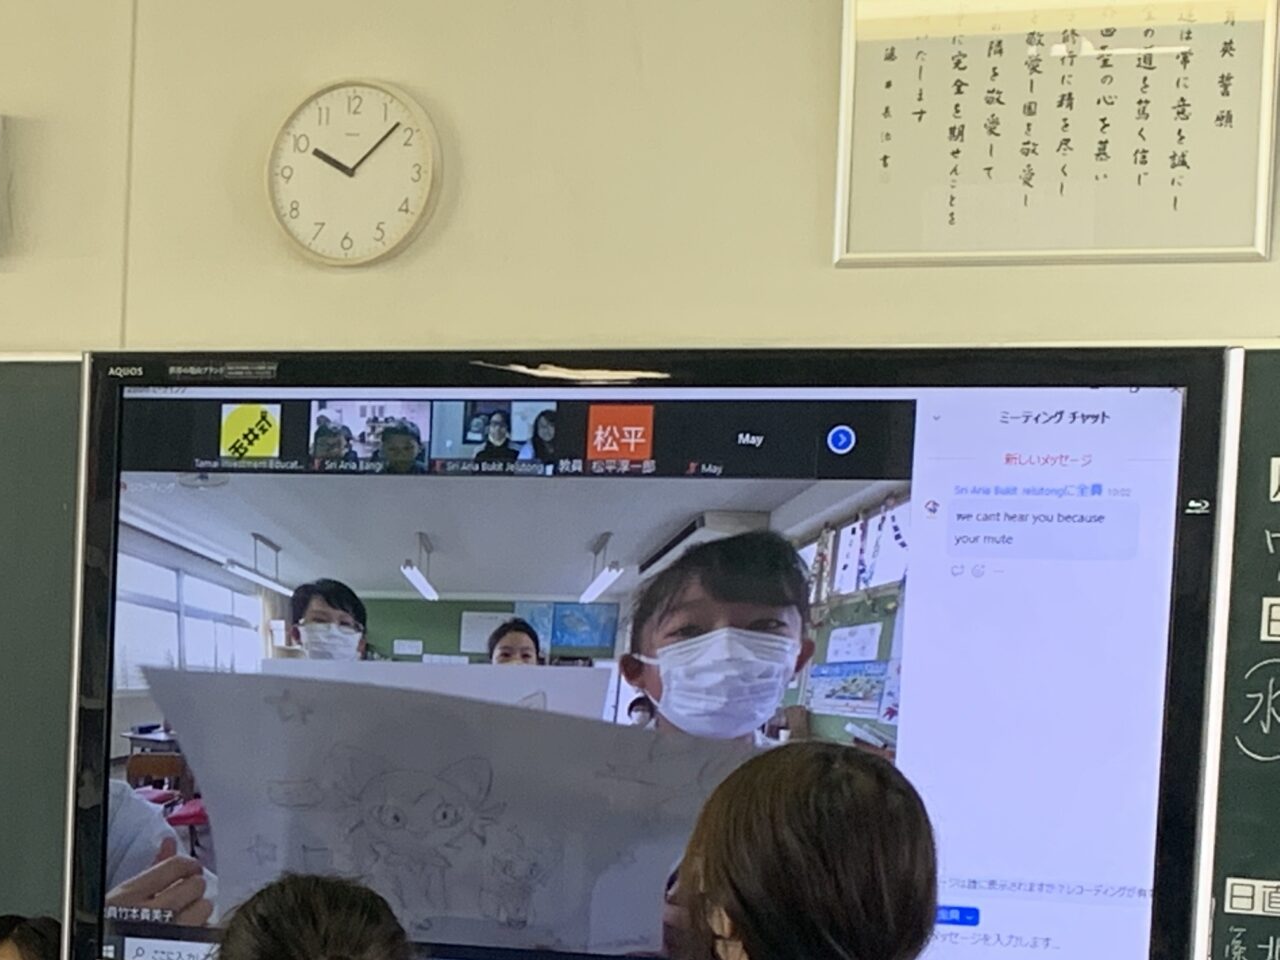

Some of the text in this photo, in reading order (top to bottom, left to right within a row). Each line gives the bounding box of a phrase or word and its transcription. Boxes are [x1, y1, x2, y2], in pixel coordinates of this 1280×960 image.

[347, 95, 363, 115] 12
[382, 103, 388, 122] 1
[318, 106, 330, 126] 11
[293, 134, 310, 153] 10
[402, 127, 413, 146] 2
[281, 165, 294, 184] 9
[411, 163, 422, 182] 3
[289, 200, 300, 219] 8
[398, 197, 410, 215] 4
[312, 222, 326, 240] 7
[373, 222, 385, 241] 5
[340, 232, 353, 250] 6
[108, 366, 143, 377] AQUOS
[594, 424, 646, 451] 松平
[737, 432, 764, 446] May
[701, 464, 722, 475] May
[1032, 514, 1054, 525] you
[1057, 513, 1106, 524] because
[954, 534, 1014, 546] your mute
